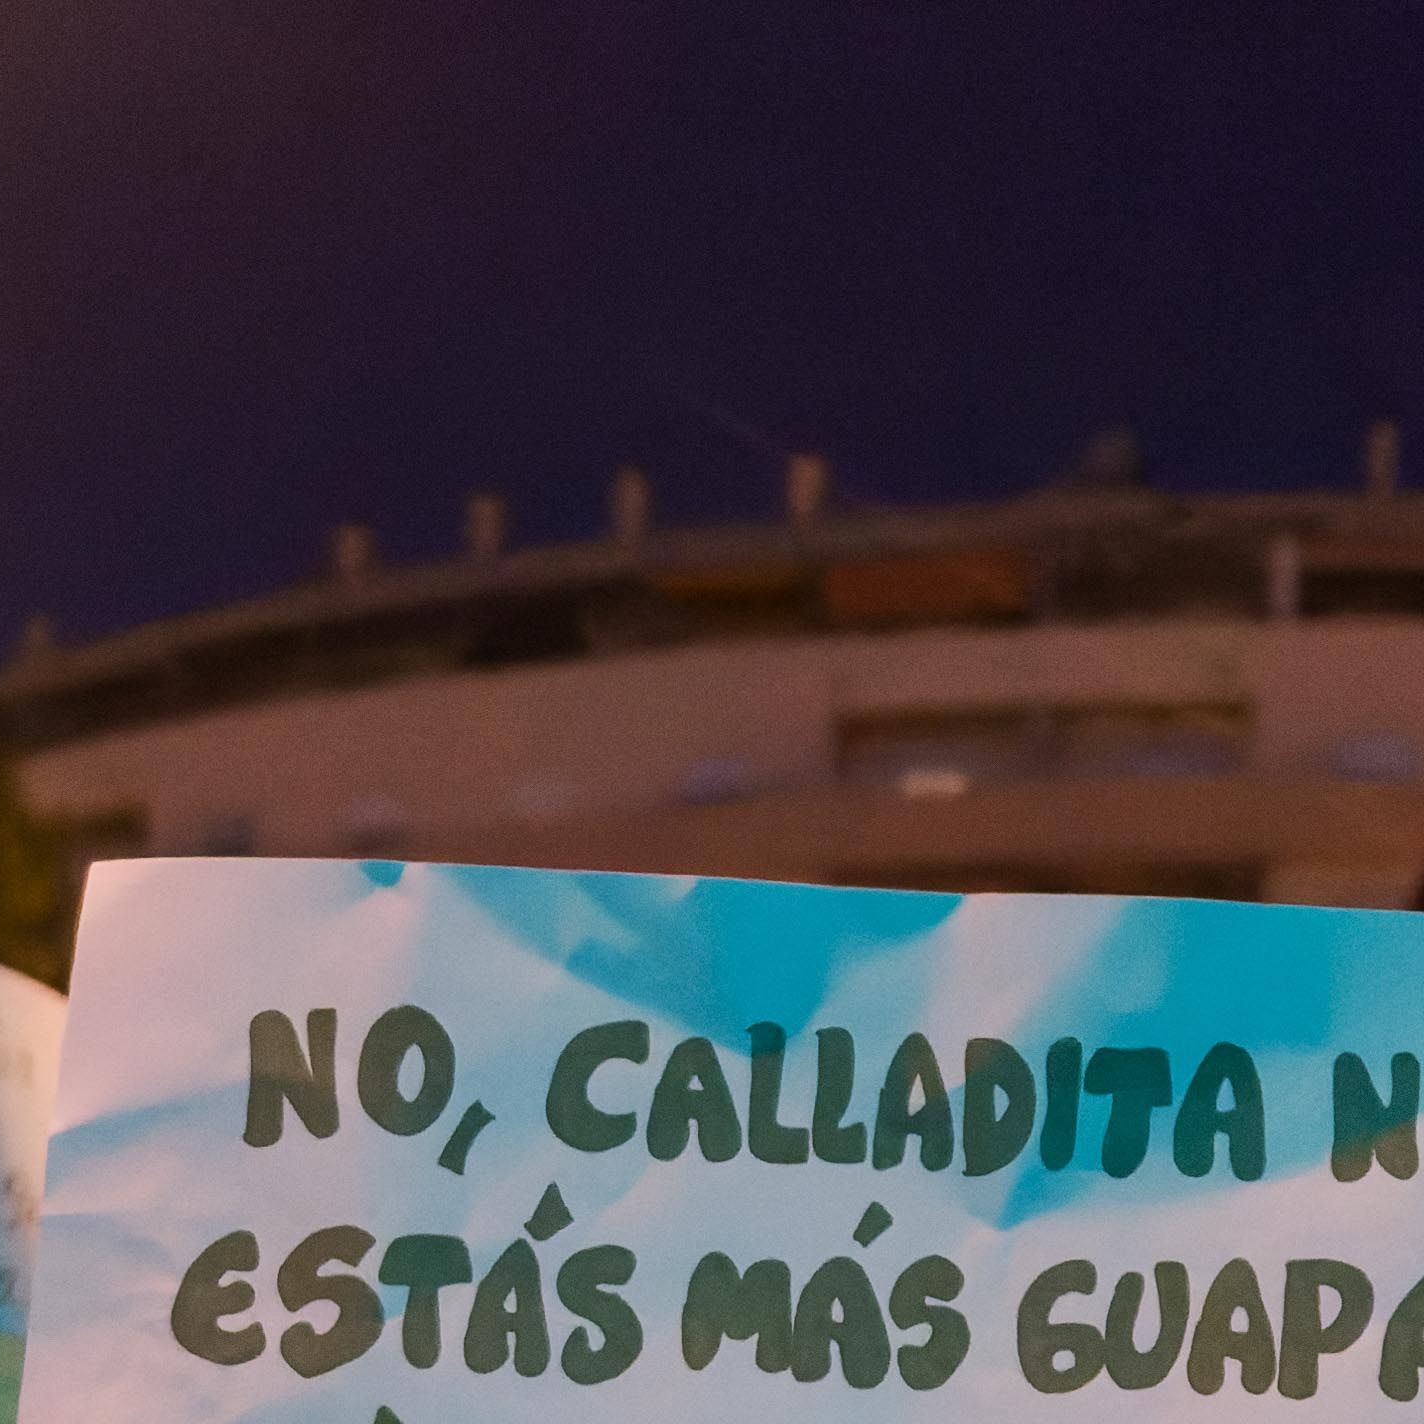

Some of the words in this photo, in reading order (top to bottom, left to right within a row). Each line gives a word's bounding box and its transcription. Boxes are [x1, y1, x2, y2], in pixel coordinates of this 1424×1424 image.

[243, 1005, 495, 1175] NO,
[546, 1021, 1265, 1181] CALLADITA
[171, 1184, 642, 1385] ESTÁS
[681, 1202, 970, 1390] MÁS
